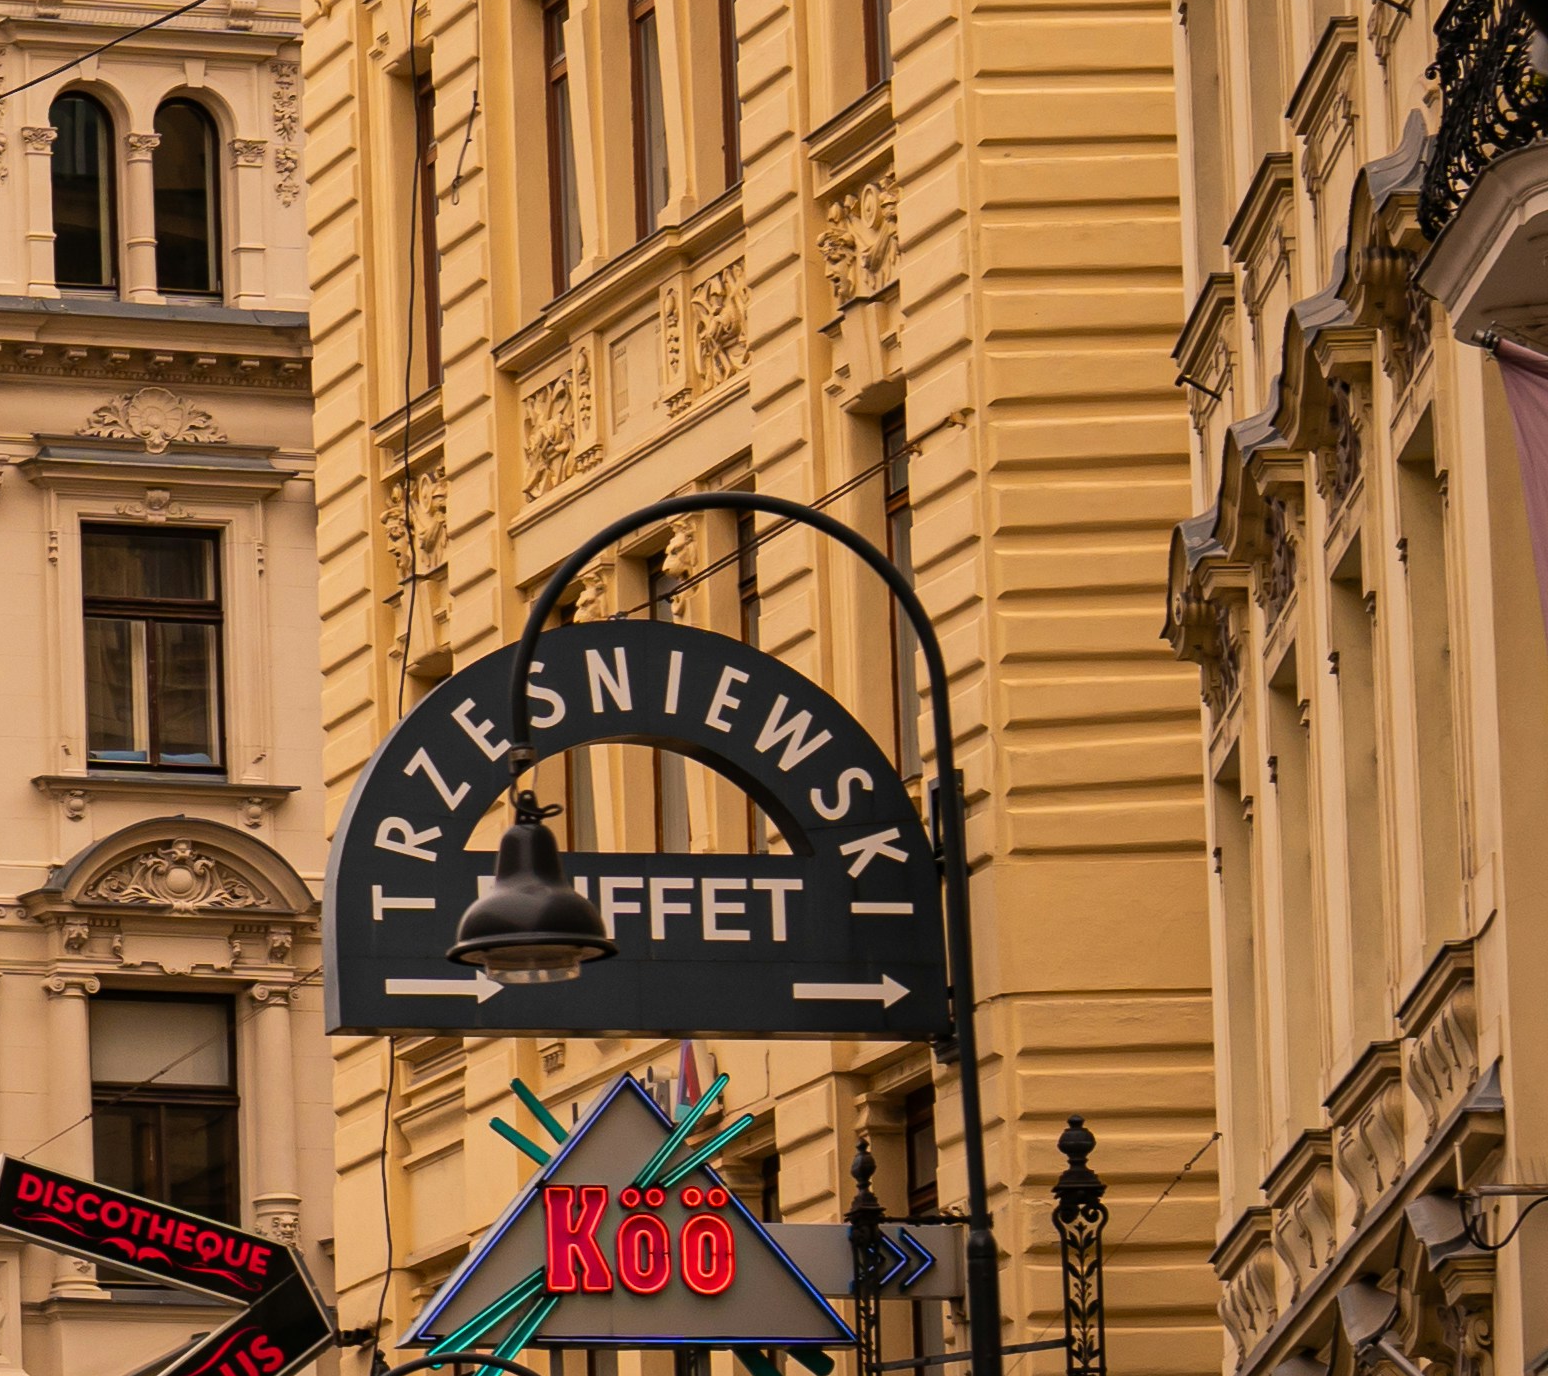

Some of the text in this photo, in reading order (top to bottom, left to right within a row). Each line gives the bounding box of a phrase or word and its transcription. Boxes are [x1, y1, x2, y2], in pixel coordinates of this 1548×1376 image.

[372, 647, 914, 920] TRZESNIEWSKI
[477, 876, 803, 942] FFET
[16, 1172, 272, 1276] DISCOTHEQUE
